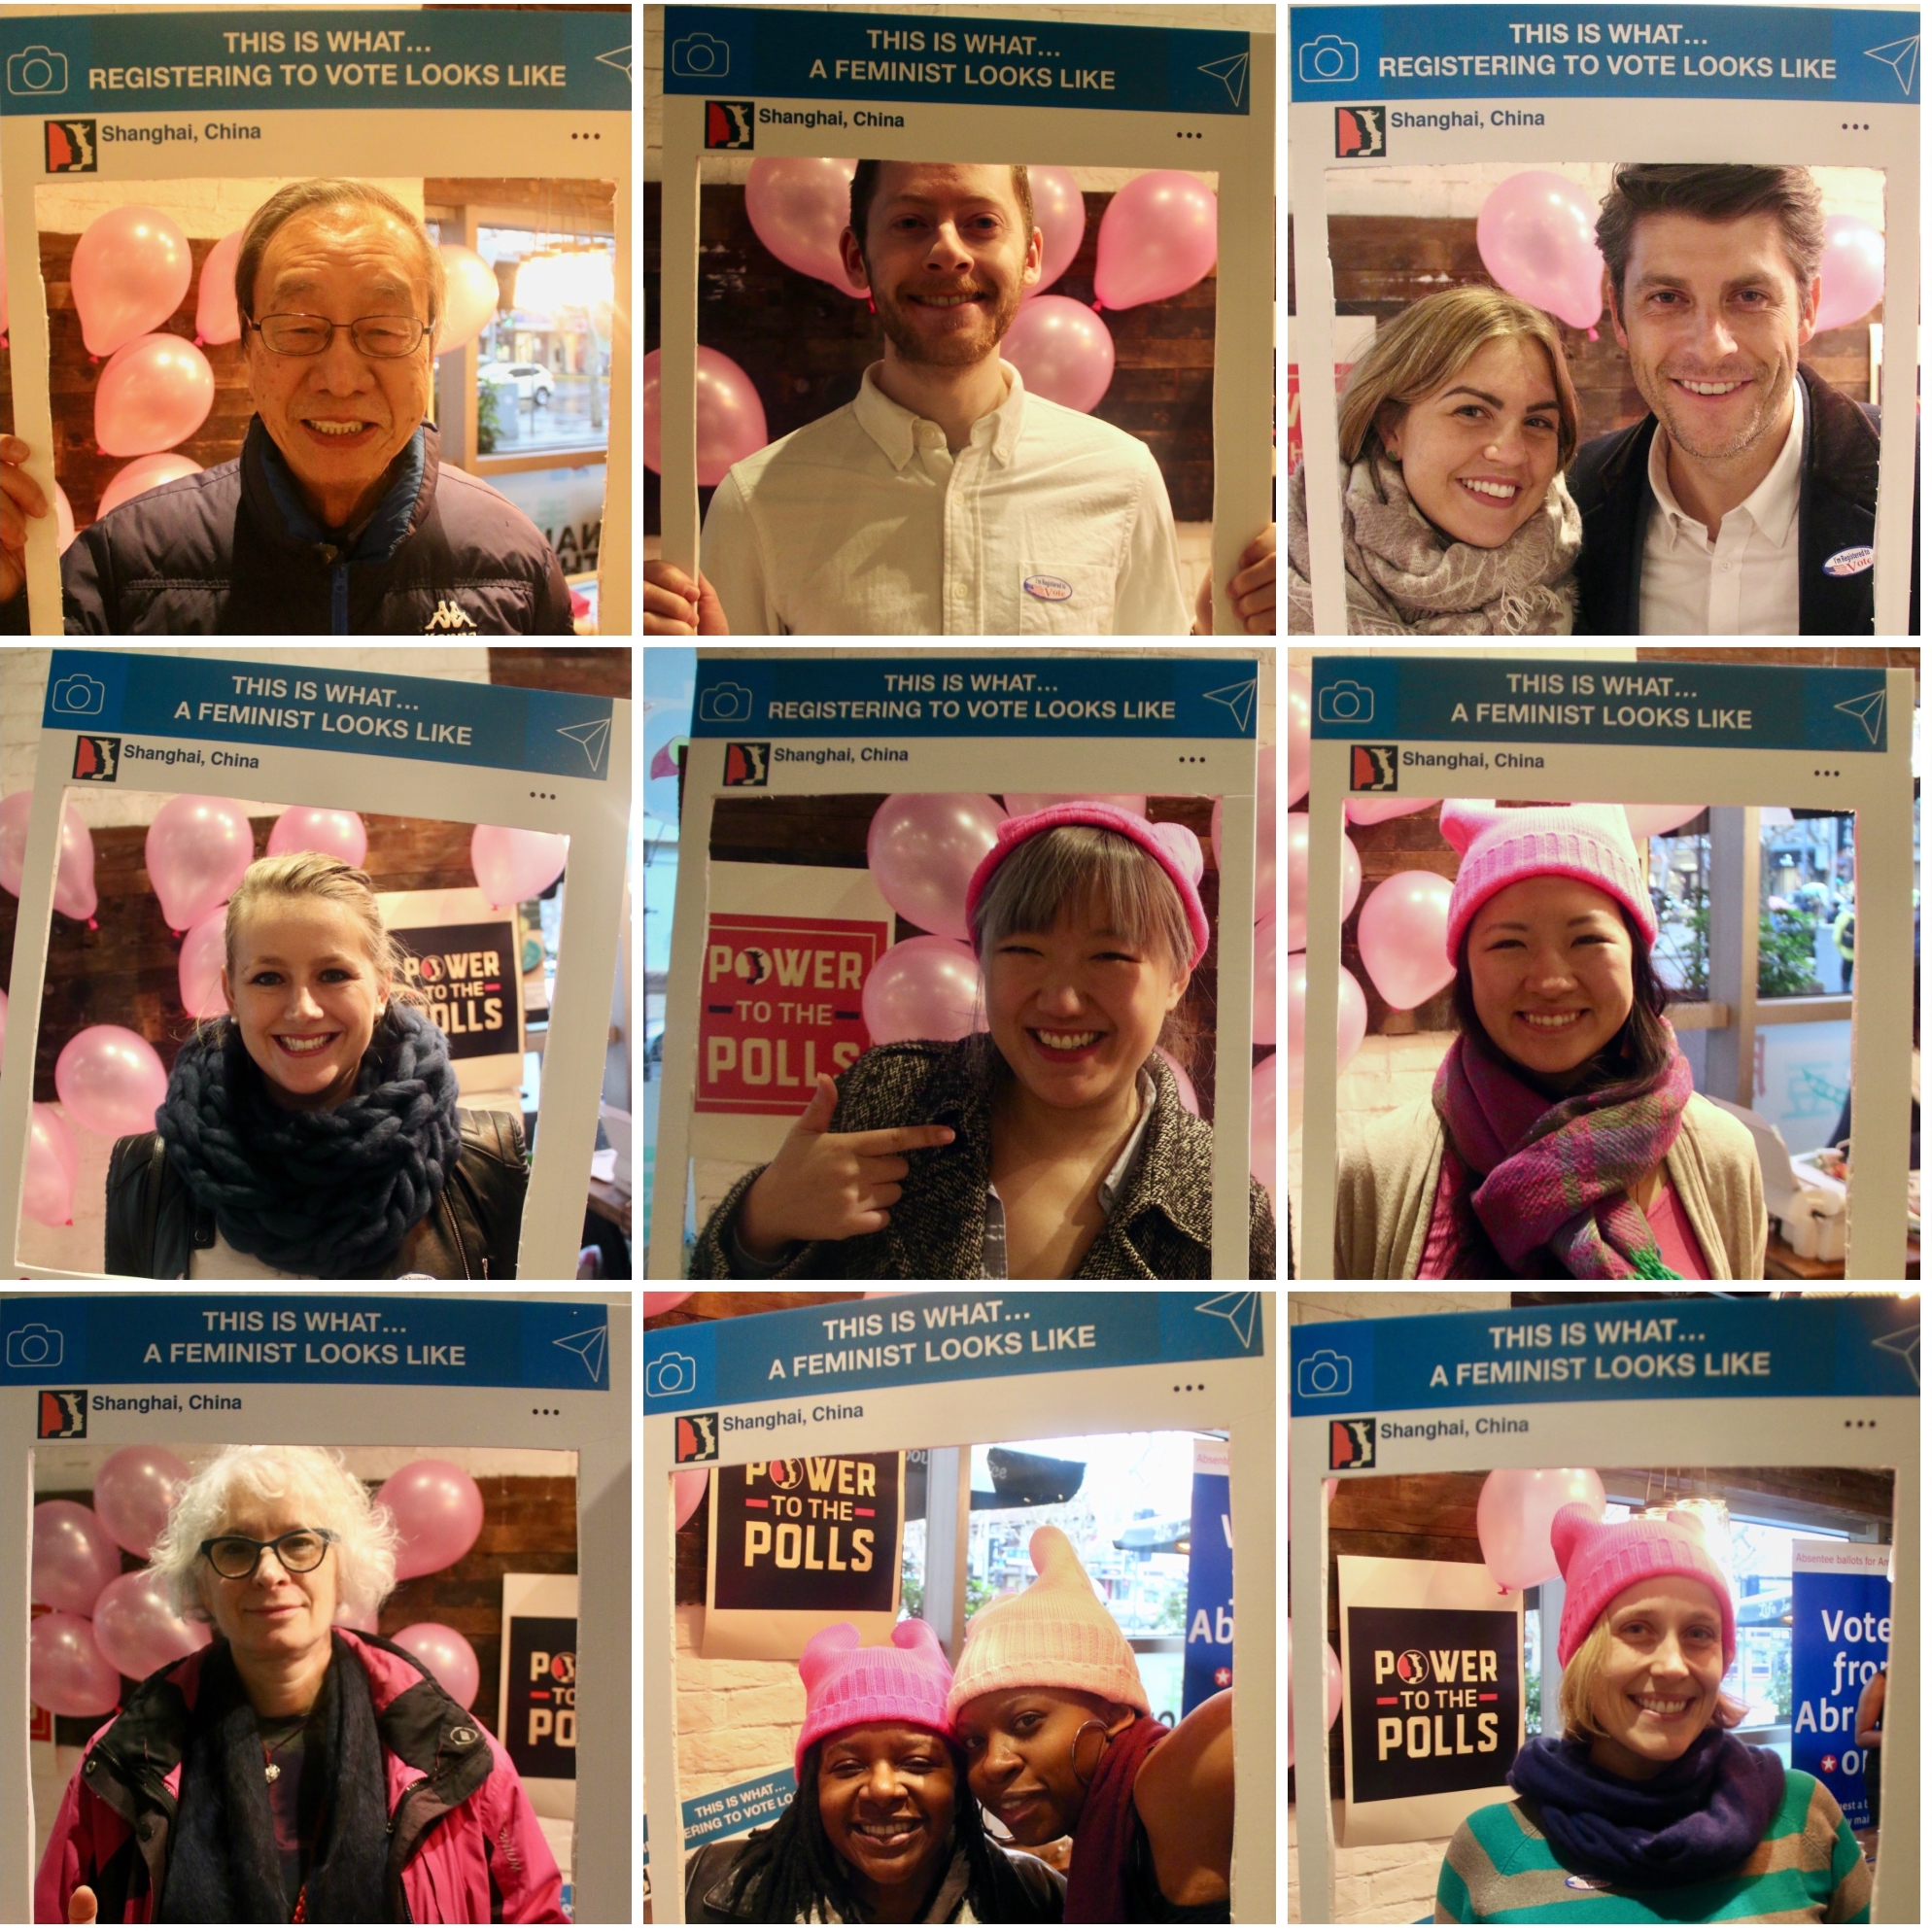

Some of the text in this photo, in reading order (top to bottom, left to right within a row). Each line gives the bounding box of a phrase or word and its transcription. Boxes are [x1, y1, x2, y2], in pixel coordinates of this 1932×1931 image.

[224, 31, 285, 52] THIS
[294, 31, 319, 52] IS
[867, 30, 925, 51] THIS
[934, 33, 956, 52] IS
[1509, 23, 1569, 43] THIS
[1578, 23, 1601, 43] IS
[89, 64, 566, 88] REGISTERING TO VOTE LOOKS LIKE
[810, 59, 1115, 89] A FEMINIST LOOKS LIKE
[1380, 54, 1836, 79] REGISTERING TO VOTE LOOKS LIKE
[759, 108, 904, 128] Shanghai, China
[1392, 111, 1544, 130] Shanghai, China
[102, 123, 260, 145] Shanghai, China
[1846, 557, 1873, 572] Vote
[232, 676, 287, 698] THIS
[295, 681, 317, 700] IS
[884, 674, 935, 691] THIS
[943, 674, 963, 691] IS
[1506, 673, 1564, 694] THIS
[1572, 675, 1595, 695] IS
[769, 701, 1175, 718] REGISTERING TO VOTE LOOKS LIKE
[1451, 704, 1751, 729] A FEMINIST LOOKS LIKE
[174, 702, 471, 745] A FEMINIST LOOKS LIKE
[124, 744, 259, 769] Shanghai, China
[775, 747, 908, 765] Shanghai, China
[1403, 751, 1544, 770] Shanghai, China
[708, 945, 862, 990] POWER
[424, 981, 485, 1001] TO THE
[418, 997, 503, 1035] OLLS
[736, 1000, 833, 1026] TO THE
[203, 1311, 263, 1330] THIS
[273, 1312, 296, 1331] IS
[823, 1314, 882, 1340] THIS
[891, 1311, 915, 1332] IS
[1489, 1324, 1552, 1349] THIS
[1561, 1323, 1586, 1345] IS
[144, 1343, 466, 1365] A FEMINIST LOOKS LIKE
[769, 1326, 1095, 1379] A FEMINIST LOOKS LIKE
[1430, 1353, 1770, 1387] A FEMINIST LOOKS LIKE
[92, 1395, 241, 1414] Shanghai, China
[723, 1405, 863, 1431] Shanghai, China
[1381, 1418, 1529, 1440] Shanghai, China
[771, 1495, 853, 1522] TO THE
[744, 1521, 875, 1572] POLLS
[1795, 1553, 1834, 1565] Absentee
[1836, 1555, 1863, 1566] ballots
[1865, 1556, 1876, 1567] for
[1821, 1609, 1893, 1643] Vote
[1374, 1649, 1499, 1685] POWER
[1399, 1689, 1477, 1710] TO THE
[1794, 1697, 1857, 1734] Abr
[1377, 1712, 1499, 1761] POLLS
[694, 1801, 724, 1818] THIS
[725, 1796, 739, 1810] IS
[723, 1811, 742, 1825] TO
[743, 1801, 776, 1818] VOTE
